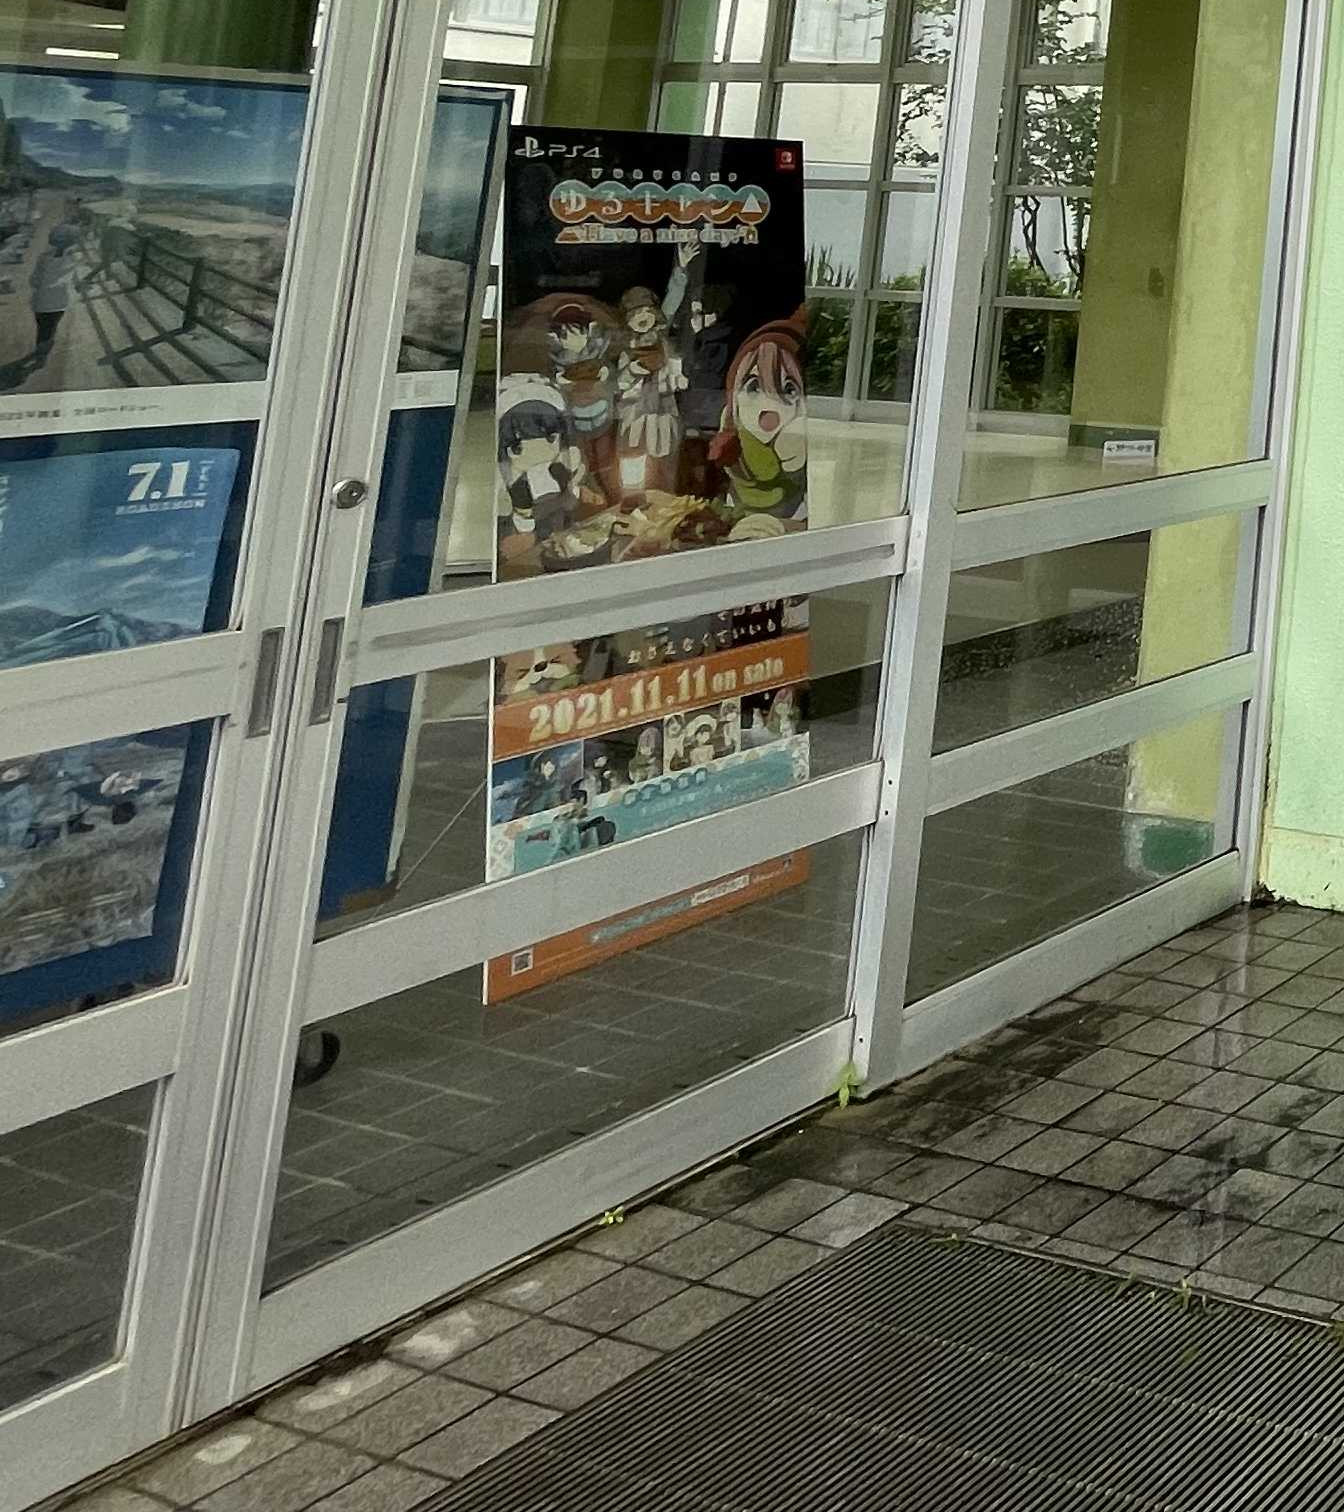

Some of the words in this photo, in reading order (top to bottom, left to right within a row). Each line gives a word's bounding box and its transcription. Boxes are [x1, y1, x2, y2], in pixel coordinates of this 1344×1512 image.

[548, 144, 602, 159] PS4
[127, 460, 190, 501] 7.1
[528, 665, 707, 743] 2021.11.11
[711, 668, 737, 694] on
[743, 657, 784, 686] sale
